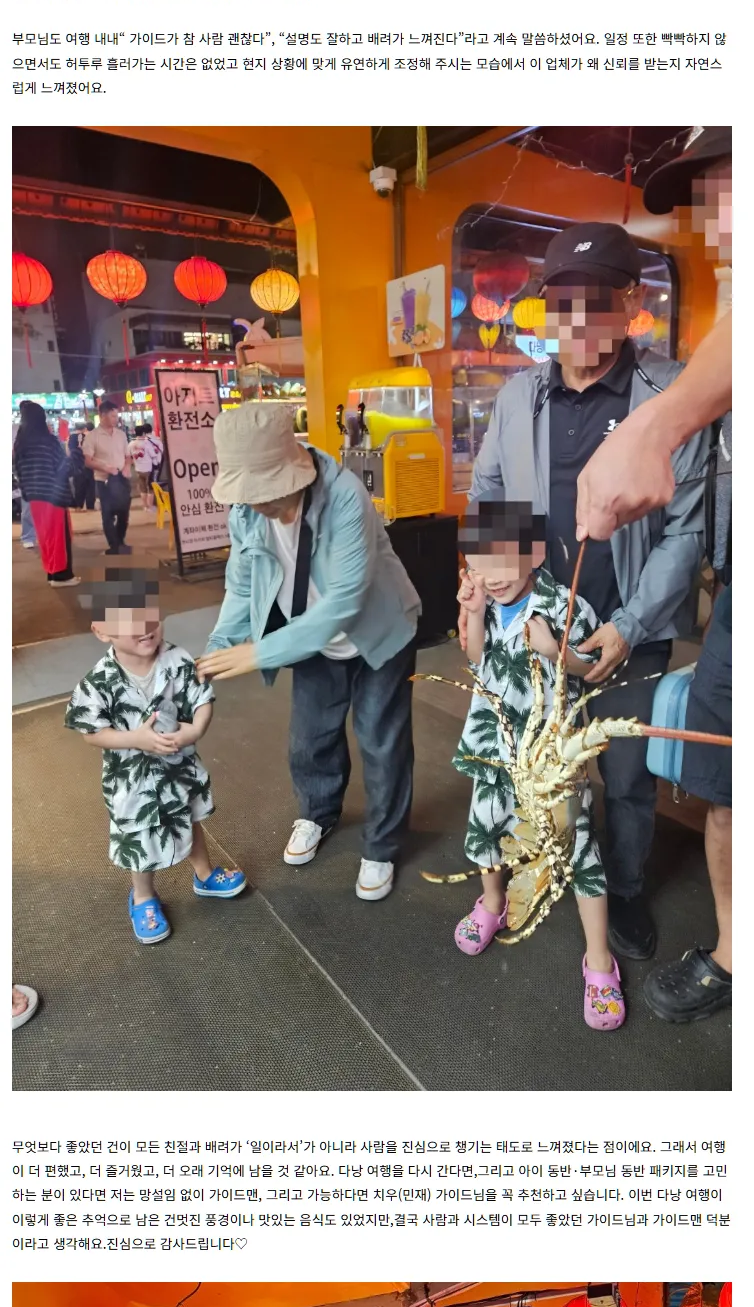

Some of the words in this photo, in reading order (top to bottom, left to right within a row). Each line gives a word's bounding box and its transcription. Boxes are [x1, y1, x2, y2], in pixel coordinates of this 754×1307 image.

[12, 57, 62, 71] 으면서도
[65, 57, 103, 71] 허투루
[106, 57, 157, 71] 흘러가는
[160, 57, 198, 71] 시간은
[201, 57, 239, 71] 없었고
[242, 57, 266, 71] 현지
[271, 57, 308, 71] 상황에
[312, 57, 336, 71] 맞게
[340, 57, 390, 71] 유연하게
[394, 57, 431, 71] 조정해
[434, 57, 473, 71] 주시는
[476, 57, 525, 71] 모습에서
[529, 57, 541, 71] 이
[545, 57, 584, 71] 업체가
[586, 57, 599, 71] 왜
[603, 57, 640, 71] 신뢰를
[644, 57, 681, 71] 받는지
[685, 57, 723, 71] 자연스
[12, 81, 37, 95] 럽게
[40, 81, 107, 95] 느껴졌어요.
[164, 387, 215, 407] 아지트
[168, 411, 215, 430] 환전소
[181, 503, 201, 517] 안심
[11, 1188, 37, 1202] 하는
[40, 1188, 65, 1202] 분이
[69, 1188, 106, 1202] 있다면
[110, 1188, 136, 1202] 저는
[139, 1188, 176, 1202] 망설임
[180, 1188, 204, 1202] 없이
[209, 1188, 262, 1203] 가이드맨,
[266, 1188, 304, 1202] 그리고
[307, 1188, 369, 1202] 가능하다면
[373, 1187, 431, 1203] 치우(민재)
[435, 1188, 498, 1202] 가이드님을
[501, 1188, 514, 1202] 꼭
[517, 1188, 568, 1202] 추천하고
[571, 1188, 624, 1202] 싶습니다.
[628, 1188, 653, 1202] 이번
[657, 1188, 682, 1202] 다낭
[685, 1188, 722, 1202] 여행이
[12, 1213, 49, 1227] 이렇게
[53, 1213, 78, 1227] 좋은
[81, 1213, 132, 1227] 추억으로
[135, 1213, 161, 1227] 남은
[164, 1213, 201, 1227] 건멋진
[204, 1213, 255, 1227] 풍경이나
[258, 1213, 296, 1227] 맛있는
[299, 1213, 337, 1227] 음식도
[340, 1213, 419, 1228] 있었지만,결국
[422, 1213, 460, 1227] 사람과
[463, 1213, 513, 1227] 시스템이
[517, 1213, 542, 1227] 모두
[545, 1213, 583, 1227] 좋았던
[587, 1213, 649, 1227] 가이드님과
[653, 1213, 702, 1227] 가이드맨
[706, 1213, 731, 1227] 덕분
[12, 1237, 50, 1251] 이라고
[53, 1237, 157, 1251] 생각해요.진심으로
